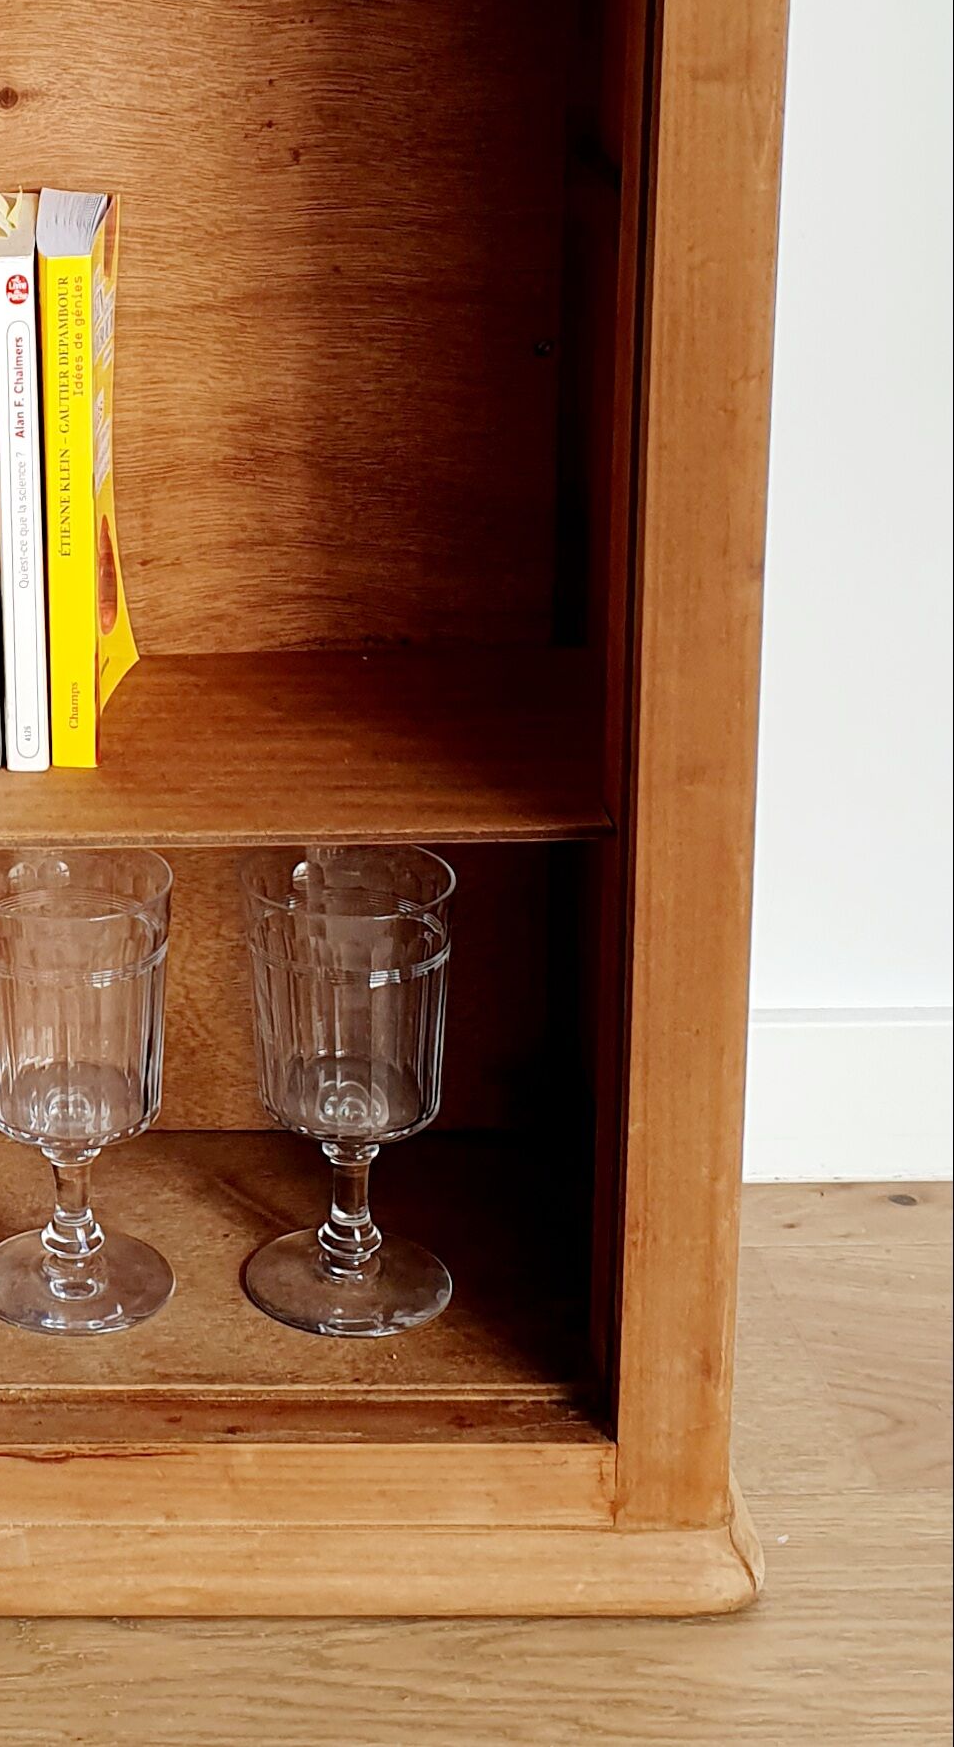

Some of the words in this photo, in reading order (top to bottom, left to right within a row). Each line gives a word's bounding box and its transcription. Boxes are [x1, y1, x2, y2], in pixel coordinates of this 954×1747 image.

[57, 276, 70, 366] DEPAMBOUR
[71, 276, 85, 327] génies
[73, 333, 83, 349] de
[13, 336, 24, 394] Chalmers
[72, 355, 84, 396] Idées
[13, 398, 25, 408] F.
[58, 370, 70, 434] GAUTIER
[14, 411, 25, 438] Alan
[16, 461, 27, 502] science
[60, 448, 71, 494] KLEIN
[17, 504, 27, 514] la
[19, 516, 30, 537] que
[58, 496, 71, 557] ÉTIENNE
[69, 681, 80, 729] Champs
